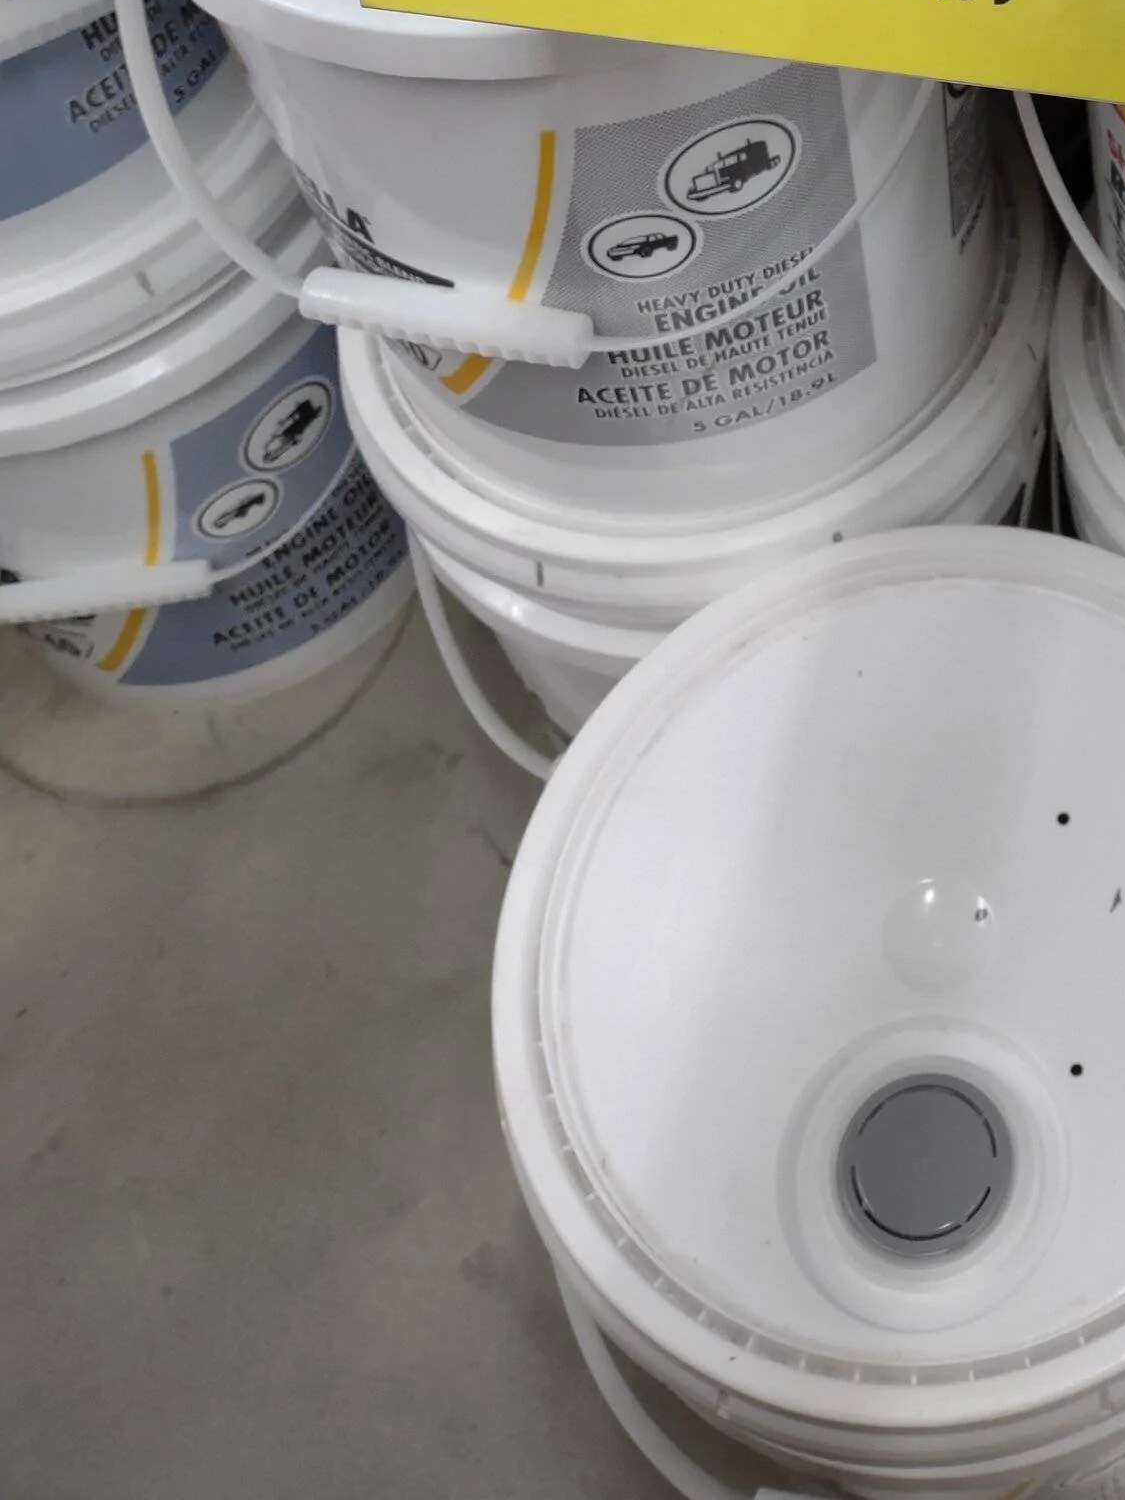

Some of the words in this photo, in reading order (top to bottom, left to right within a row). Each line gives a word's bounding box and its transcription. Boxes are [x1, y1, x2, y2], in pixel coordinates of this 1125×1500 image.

[636, 289, 699, 313] HEAVY
[707, 272, 755, 299] DUTY
[607, 336, 695, 365] HUILE
[705, 288, 825, 351] MOTEUR
[577, 382, 672, 405] ACEITE
[681, 373, 720, 398] DE
[728, 329, 831, 386] MOTOR
[621, 359, 680, 379] DIESEL
[686, 355, 709, 369] DE
[714, 336, 771, 363] HAUTE
[657, 399, 679, 415] DE
[685, 392, 726, 412] ALTA
[731, 349, 836, 400] RESISTENCIA
[692, 420, 707, 433] 5
